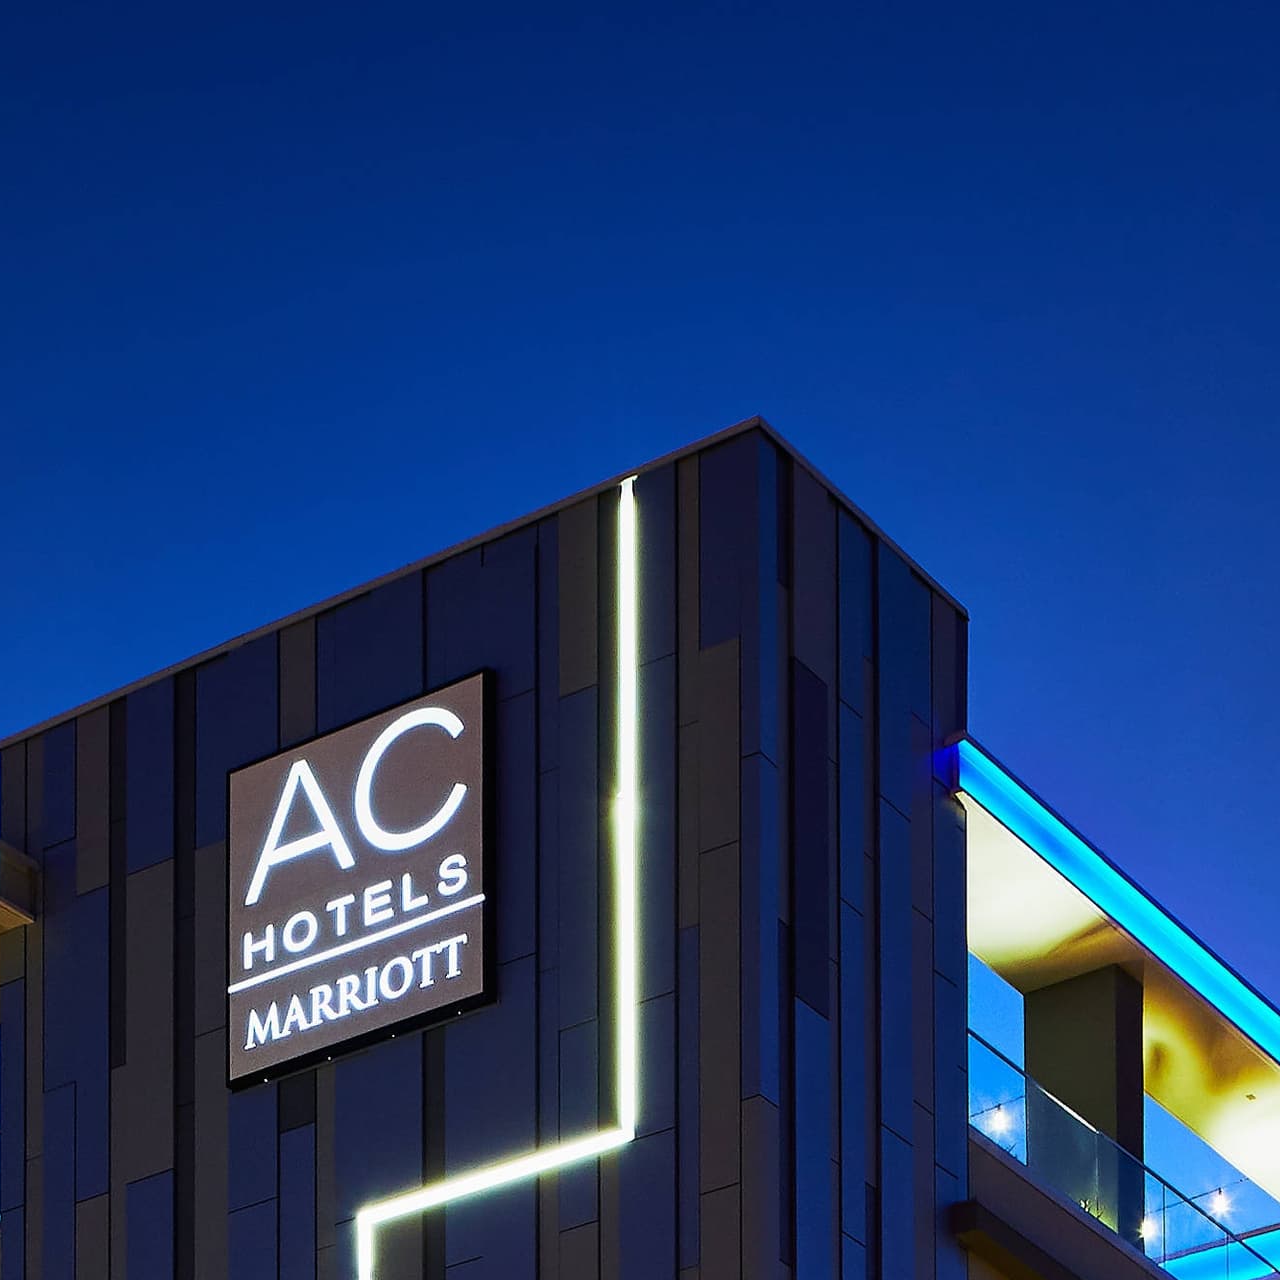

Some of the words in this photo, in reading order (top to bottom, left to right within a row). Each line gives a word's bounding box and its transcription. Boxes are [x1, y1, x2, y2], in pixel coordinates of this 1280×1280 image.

[244, 706, 468, 906] AC
[243, 853, 468, 970] HOTELS
[244, 933, 468, 1050] MARRIOTT
